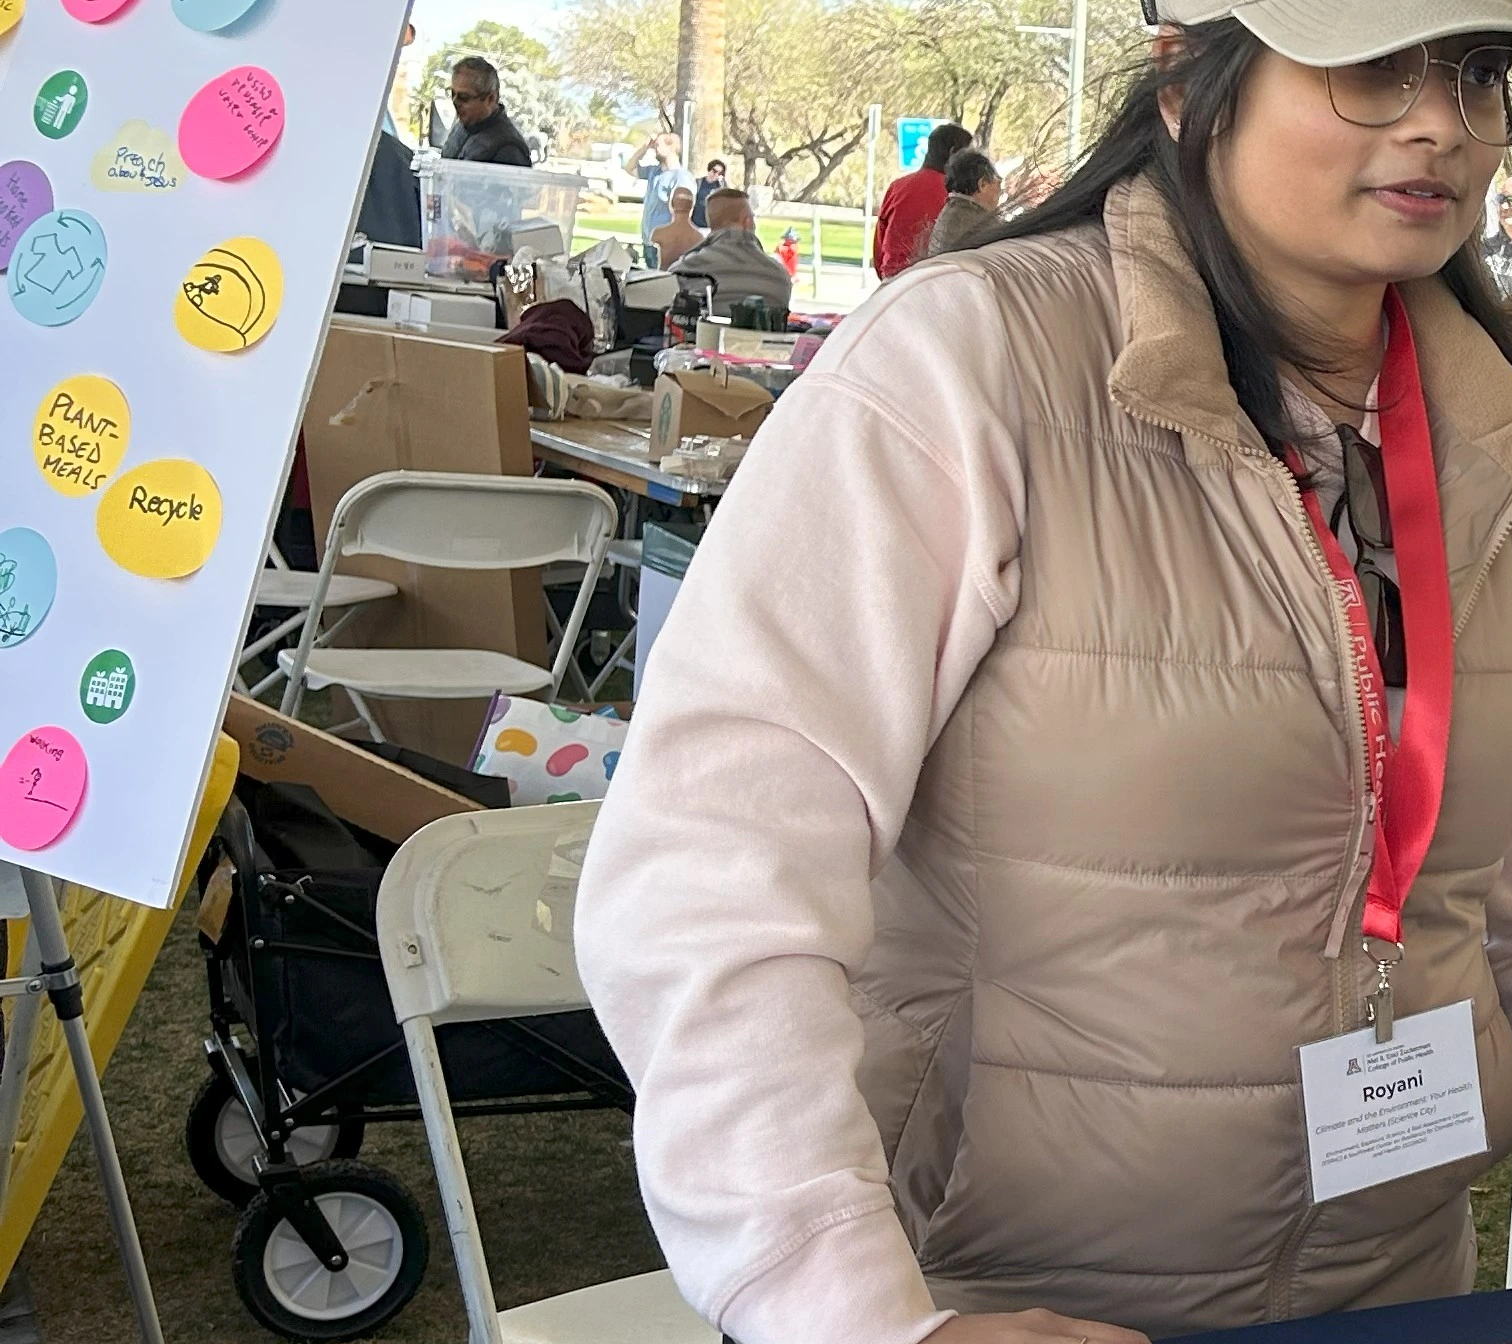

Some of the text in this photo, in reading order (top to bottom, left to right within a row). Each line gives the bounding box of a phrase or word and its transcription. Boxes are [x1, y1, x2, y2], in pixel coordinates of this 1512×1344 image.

[49, 393, 119, 439] PLANT-
[39, 423, 101, 464] BASED
[43, 454, 107, 490] MEALS
[129, 485, 203, 526] Recycle
[1363, 1070, 1424, 1103] Royani
[1315, 1121, 1346, 1135] Climate
[1348, 1114, 1363, 1126] and
[1364, 1110, 1378, 1122] the
[1356, 1122, 1386, 1135] Matters
